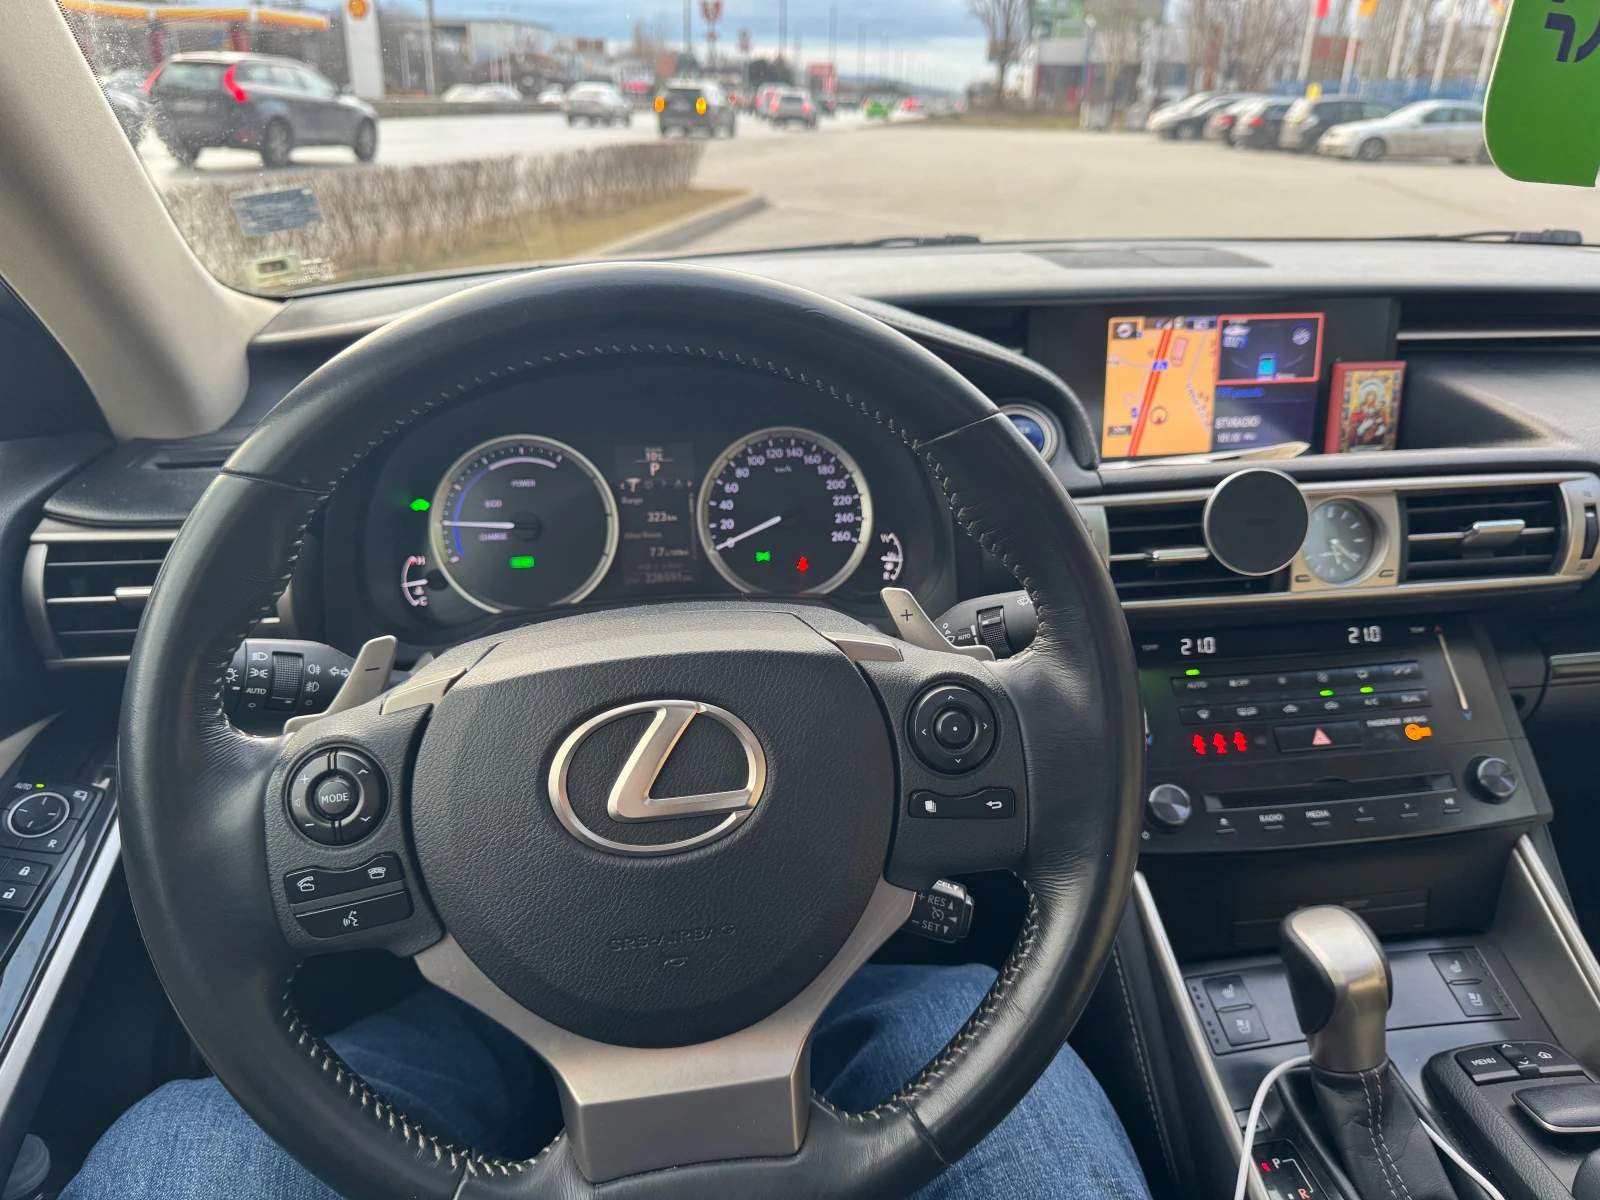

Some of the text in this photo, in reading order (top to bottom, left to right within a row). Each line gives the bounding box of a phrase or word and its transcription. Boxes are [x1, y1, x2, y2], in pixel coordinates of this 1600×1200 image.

[766, 448, 783, 459] 120
[786, 448, 803, 459] 140
[747, 456, 765, 466] 100
[804, 455, 821, 465] 160
[650, 462, 660, 476] P
[735, 467, 750, 478] 80
[818, 465, 835, 475] 180
[724, 482, 739, 494] 60
[826, 479, 846, 490] 200
[719, 500, 734, 511] 40
[832, 495, 852, 506] 220
[835, 512, 854, 524] 240
[720, 519, 735, 530] 20
[831, 531, 851, 542] 260
[958, 633, 971, 641] AUTO
[1187, 681, 1209, 689] AUTO
[246, 687, 267, 695] AUTO
[14, 782, 33, 790] AUTO
[321, 792, 350, 804] MODE
[1259, 813, 1285, 822] RADIO
[1305, 810, 1331, 819] MEDIA
[47, 839, 58, 849] R
[927, 894, 946, 907] RES
[921, 920, 941, 933] SET
[1471, 1057, 1497, 1066] MENU
[1271, 1157, 1281, 1170] P
[1297, 1188, 1310, 1200] R
